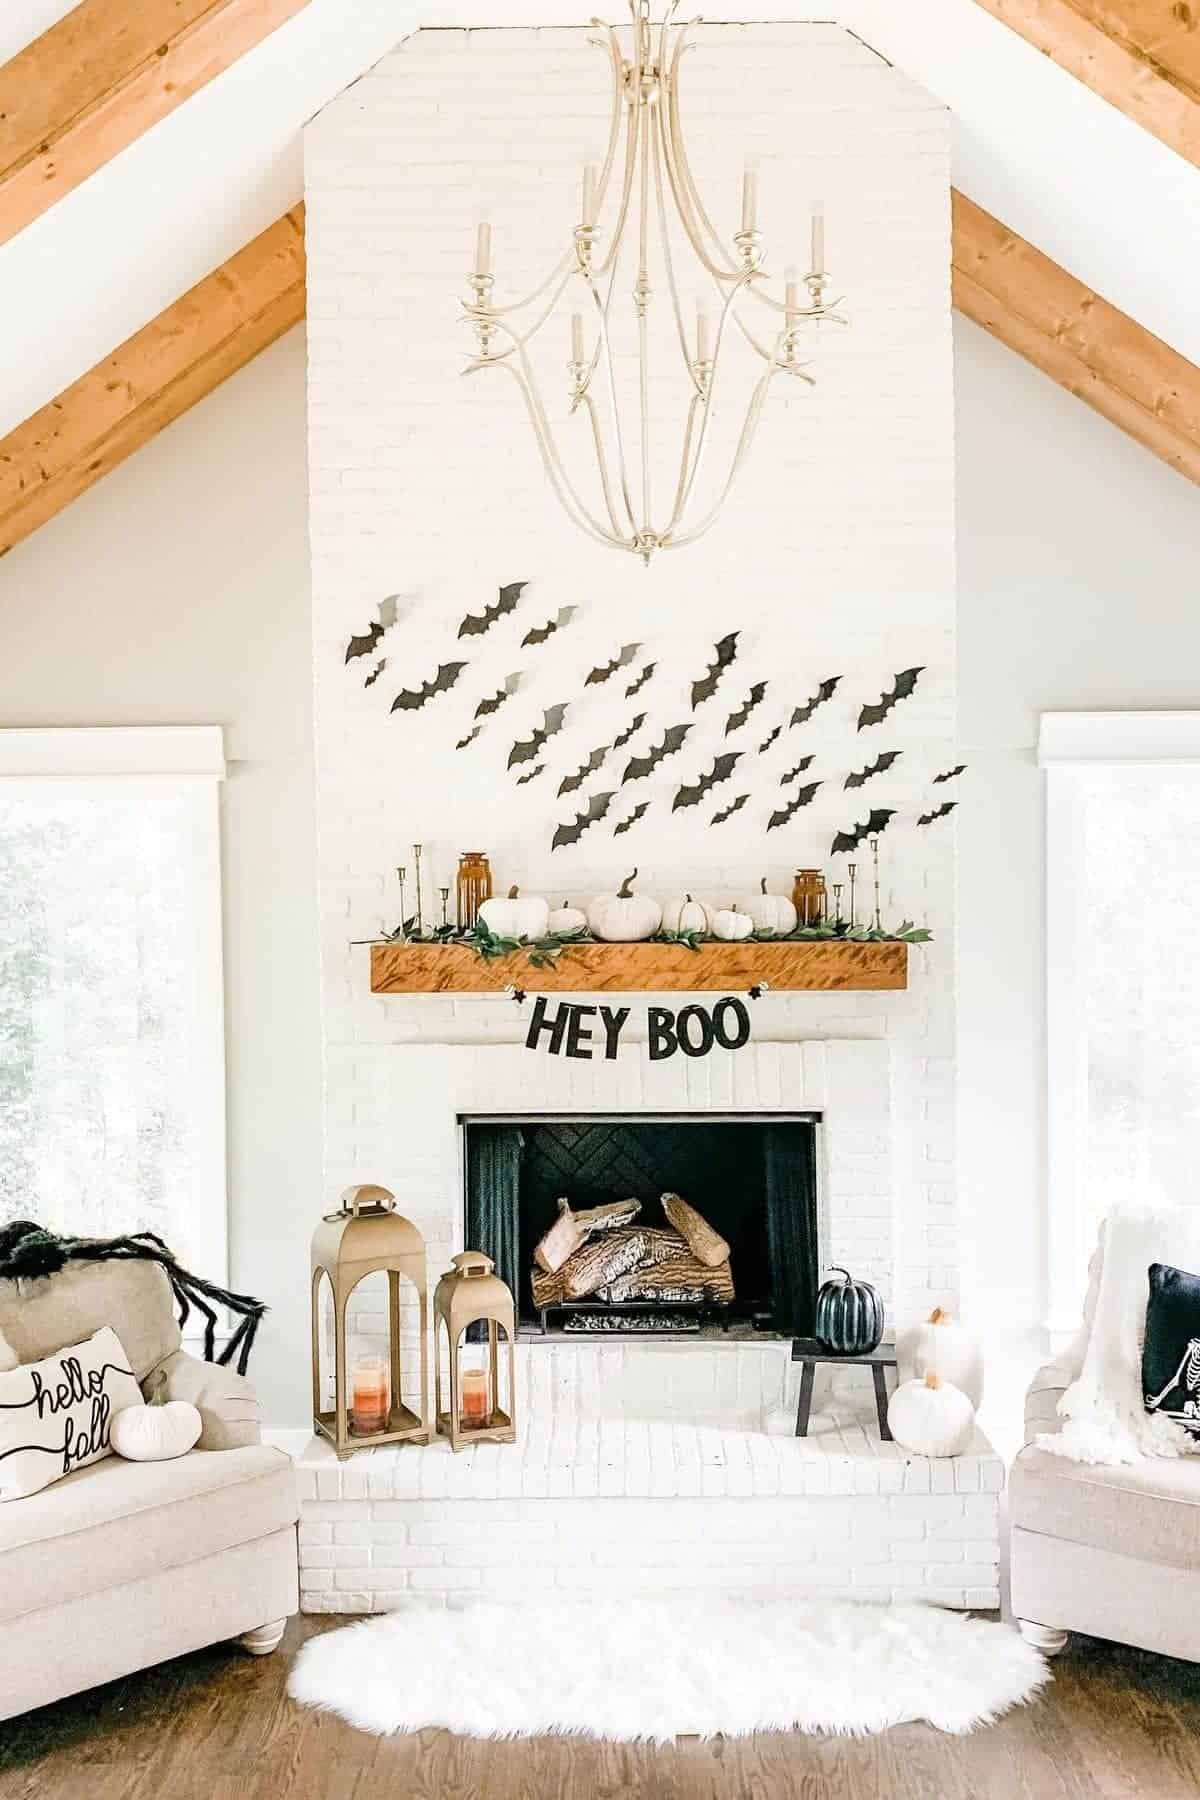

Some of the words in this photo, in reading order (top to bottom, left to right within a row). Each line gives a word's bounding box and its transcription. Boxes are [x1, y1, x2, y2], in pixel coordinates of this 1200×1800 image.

[525, 996, 631, 1060] HEY
[648, 996, 750, 1060] BOO
[29, 1357, 112, 1418] hello
[60, 1394, 111, 1473] fall
